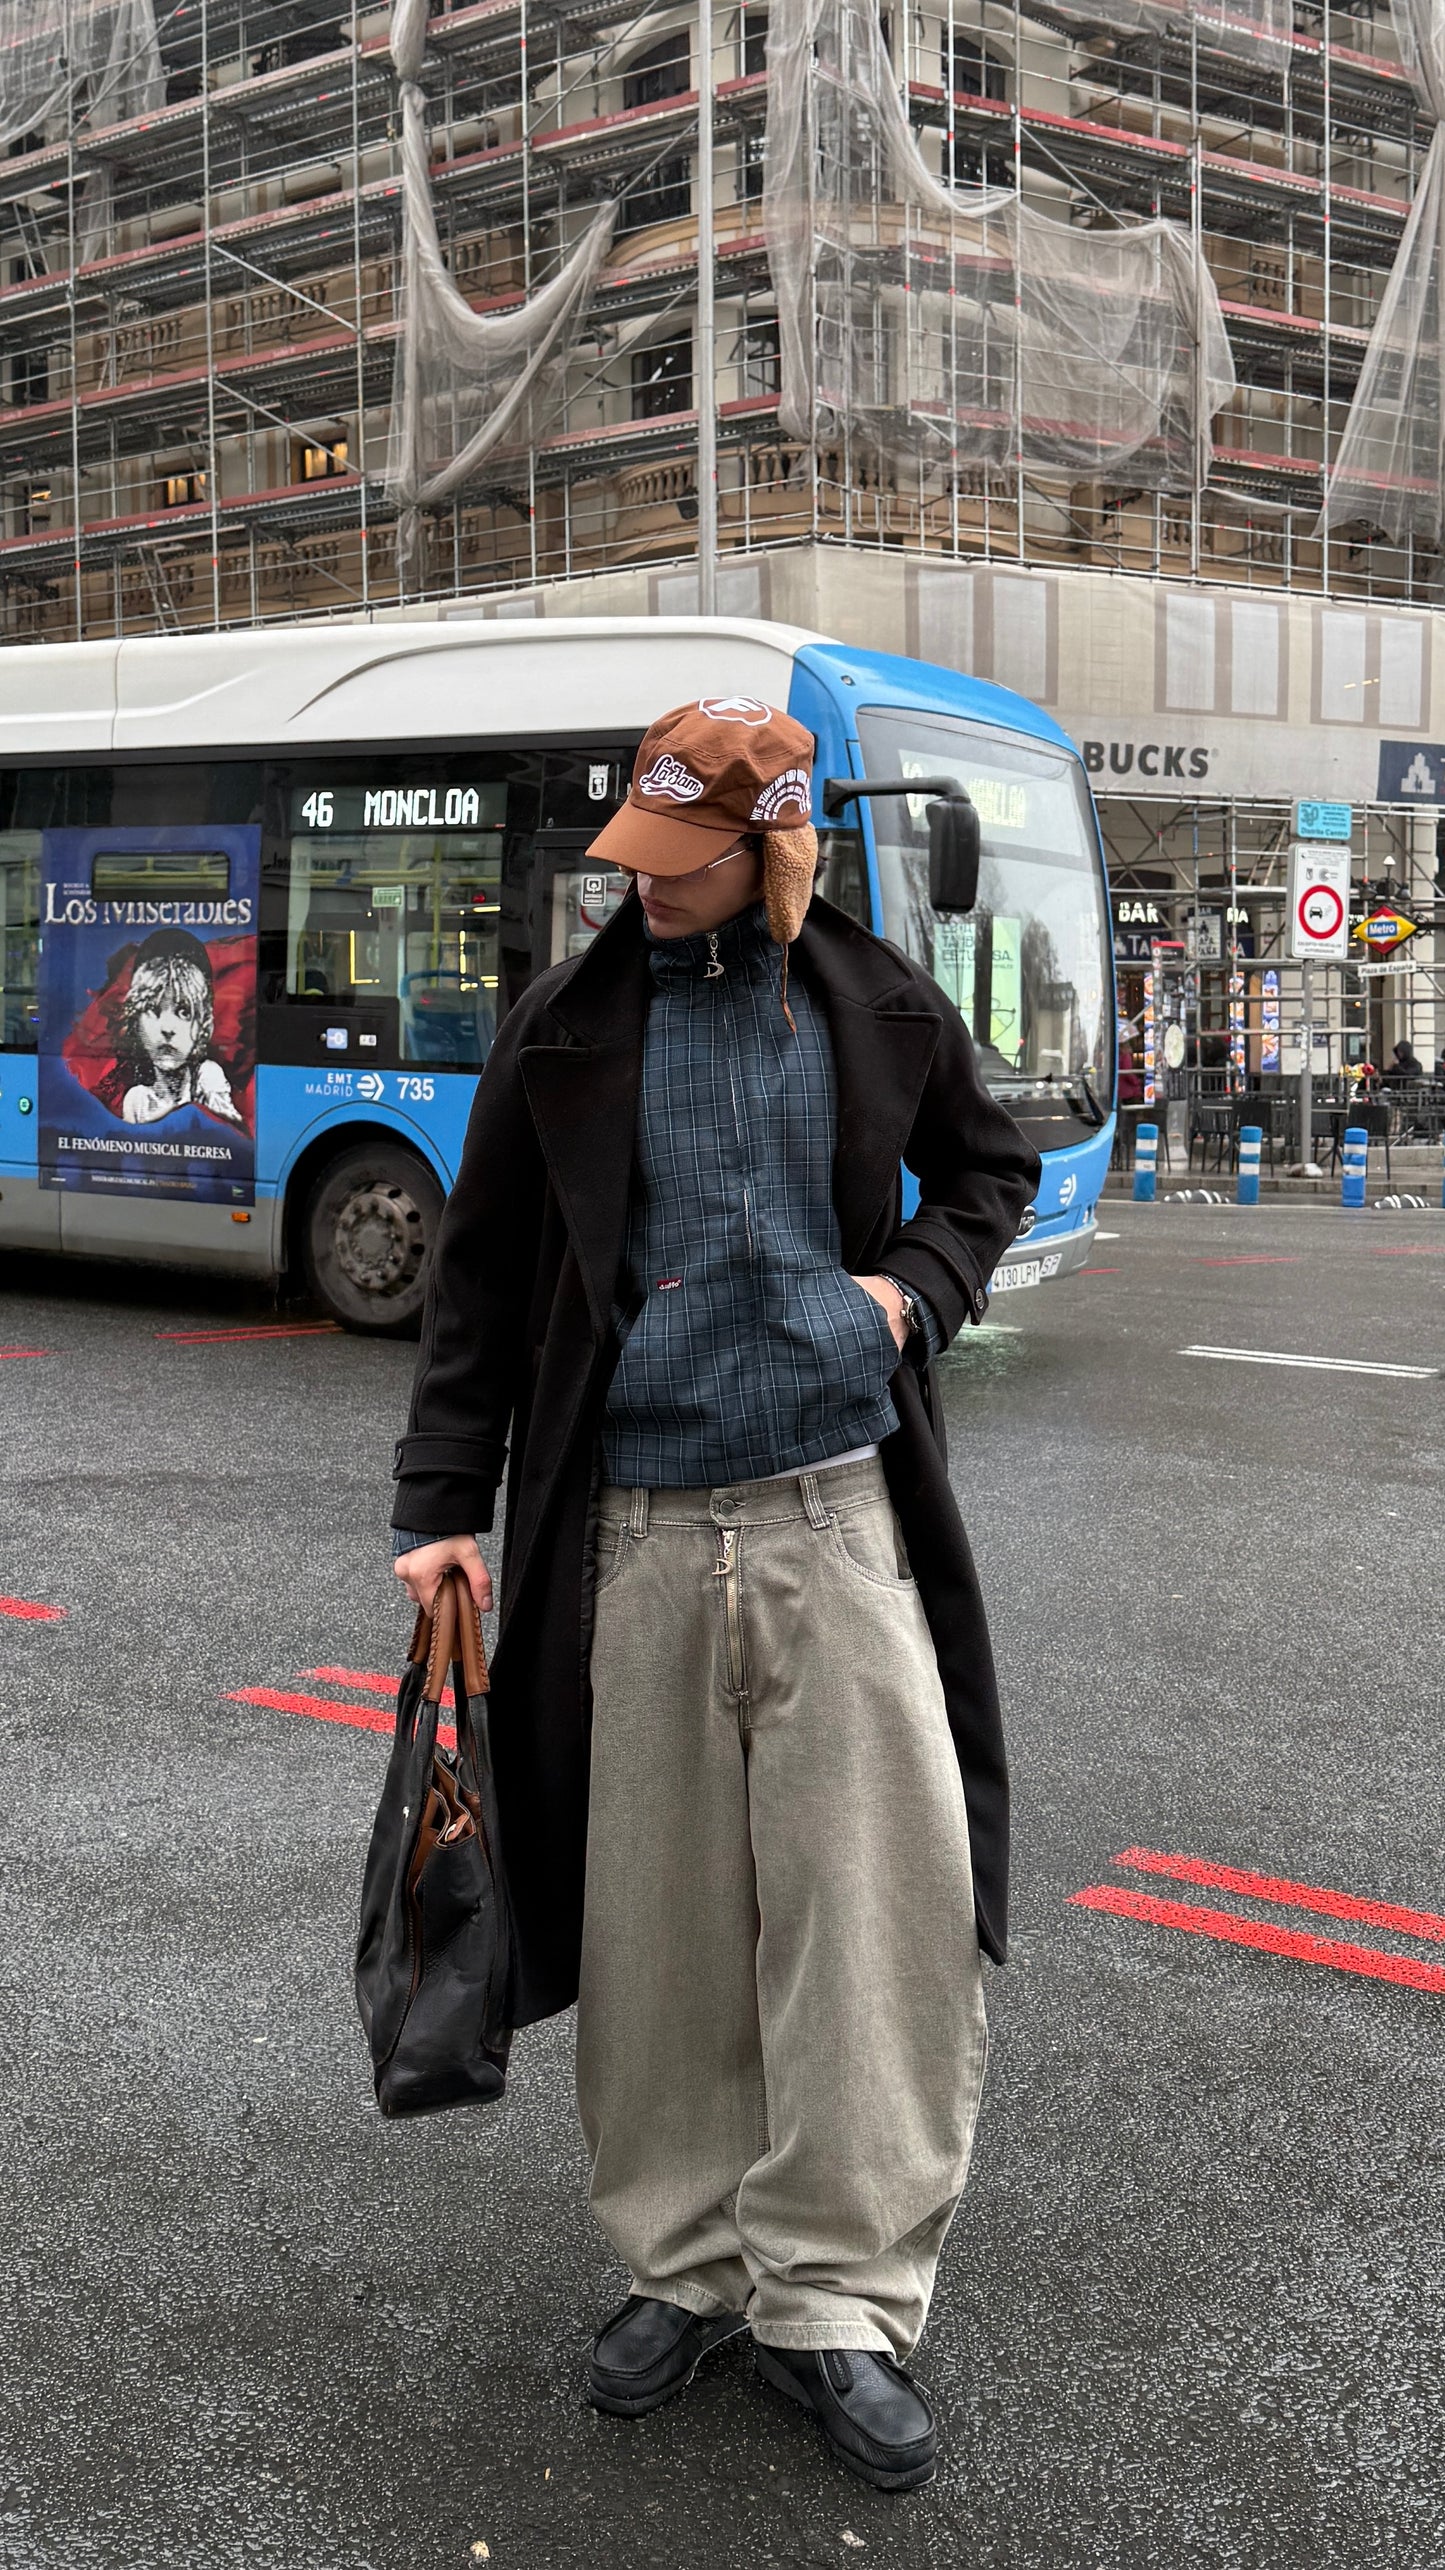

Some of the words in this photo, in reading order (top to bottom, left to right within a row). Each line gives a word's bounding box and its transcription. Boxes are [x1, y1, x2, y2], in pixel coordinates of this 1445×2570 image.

[1083, 740, 1209, 779] BUCKS
[302, 791, 334, 827] 46
[363, 788, 480, 827] MONCLOA
[44, 883, 97, 925] Los
[1118, 902, 1159, 923] BAR
[1369, 924, 1396, 934] Metro
[305, 1083, 353, 1097] MADRID
[327, 1073, 353, 1084] EMT
[397, 1077, 435, 1101] 735
[58, 1137, 71, 1149] EL
[72, 1137, 133, 1154] FENÓMENO
[134, 1143, 182, 1157] MUSICAL
[183, 1145, 232, 1160] REGRESA
[993, 1267, 1018, 1288] 4130
[1020, 1264, 1038, 1284] LPY
[1041, 1255, 1060, 1275] SP
